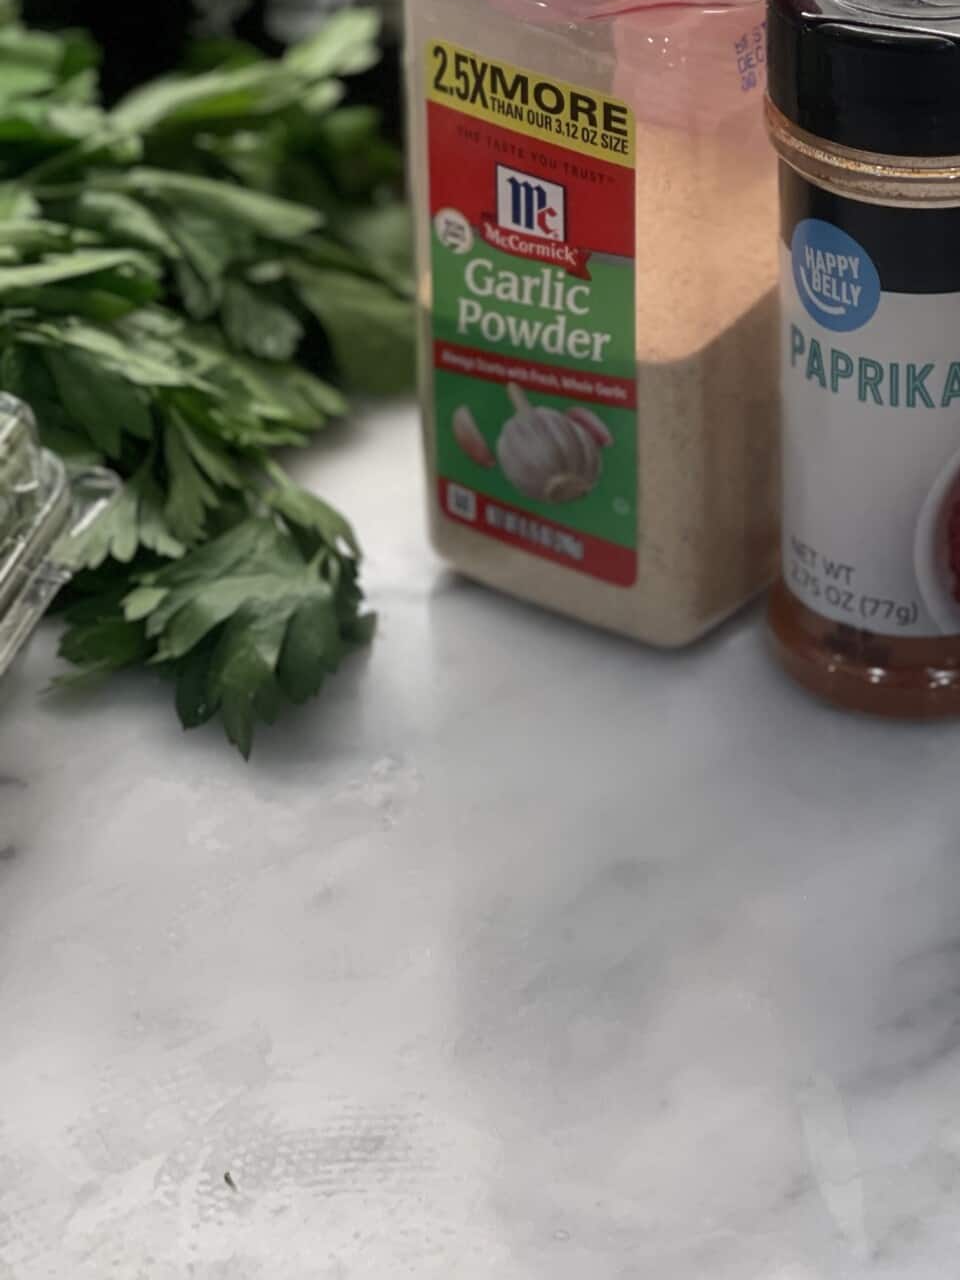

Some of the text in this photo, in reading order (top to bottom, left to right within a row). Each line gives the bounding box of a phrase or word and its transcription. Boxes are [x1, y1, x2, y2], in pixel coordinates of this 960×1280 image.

[433, 44, 629, 138] 2.5X MORE
[490, 96, 630, 156] THAN OUR 3.12 OZ SIZE
[484, 221, 577, 266] McCormick
[804, 244, 861, 280] HAPPY
[463, 258, 591, 316] Garlic
[811, 270, 865, 309] BELLY
[457, 296, 613, 364] Powder
[821, 555, 856, 587] WT
[825, 584, 856, 613] OZ
[859, 594, 920, 627] (77g)
